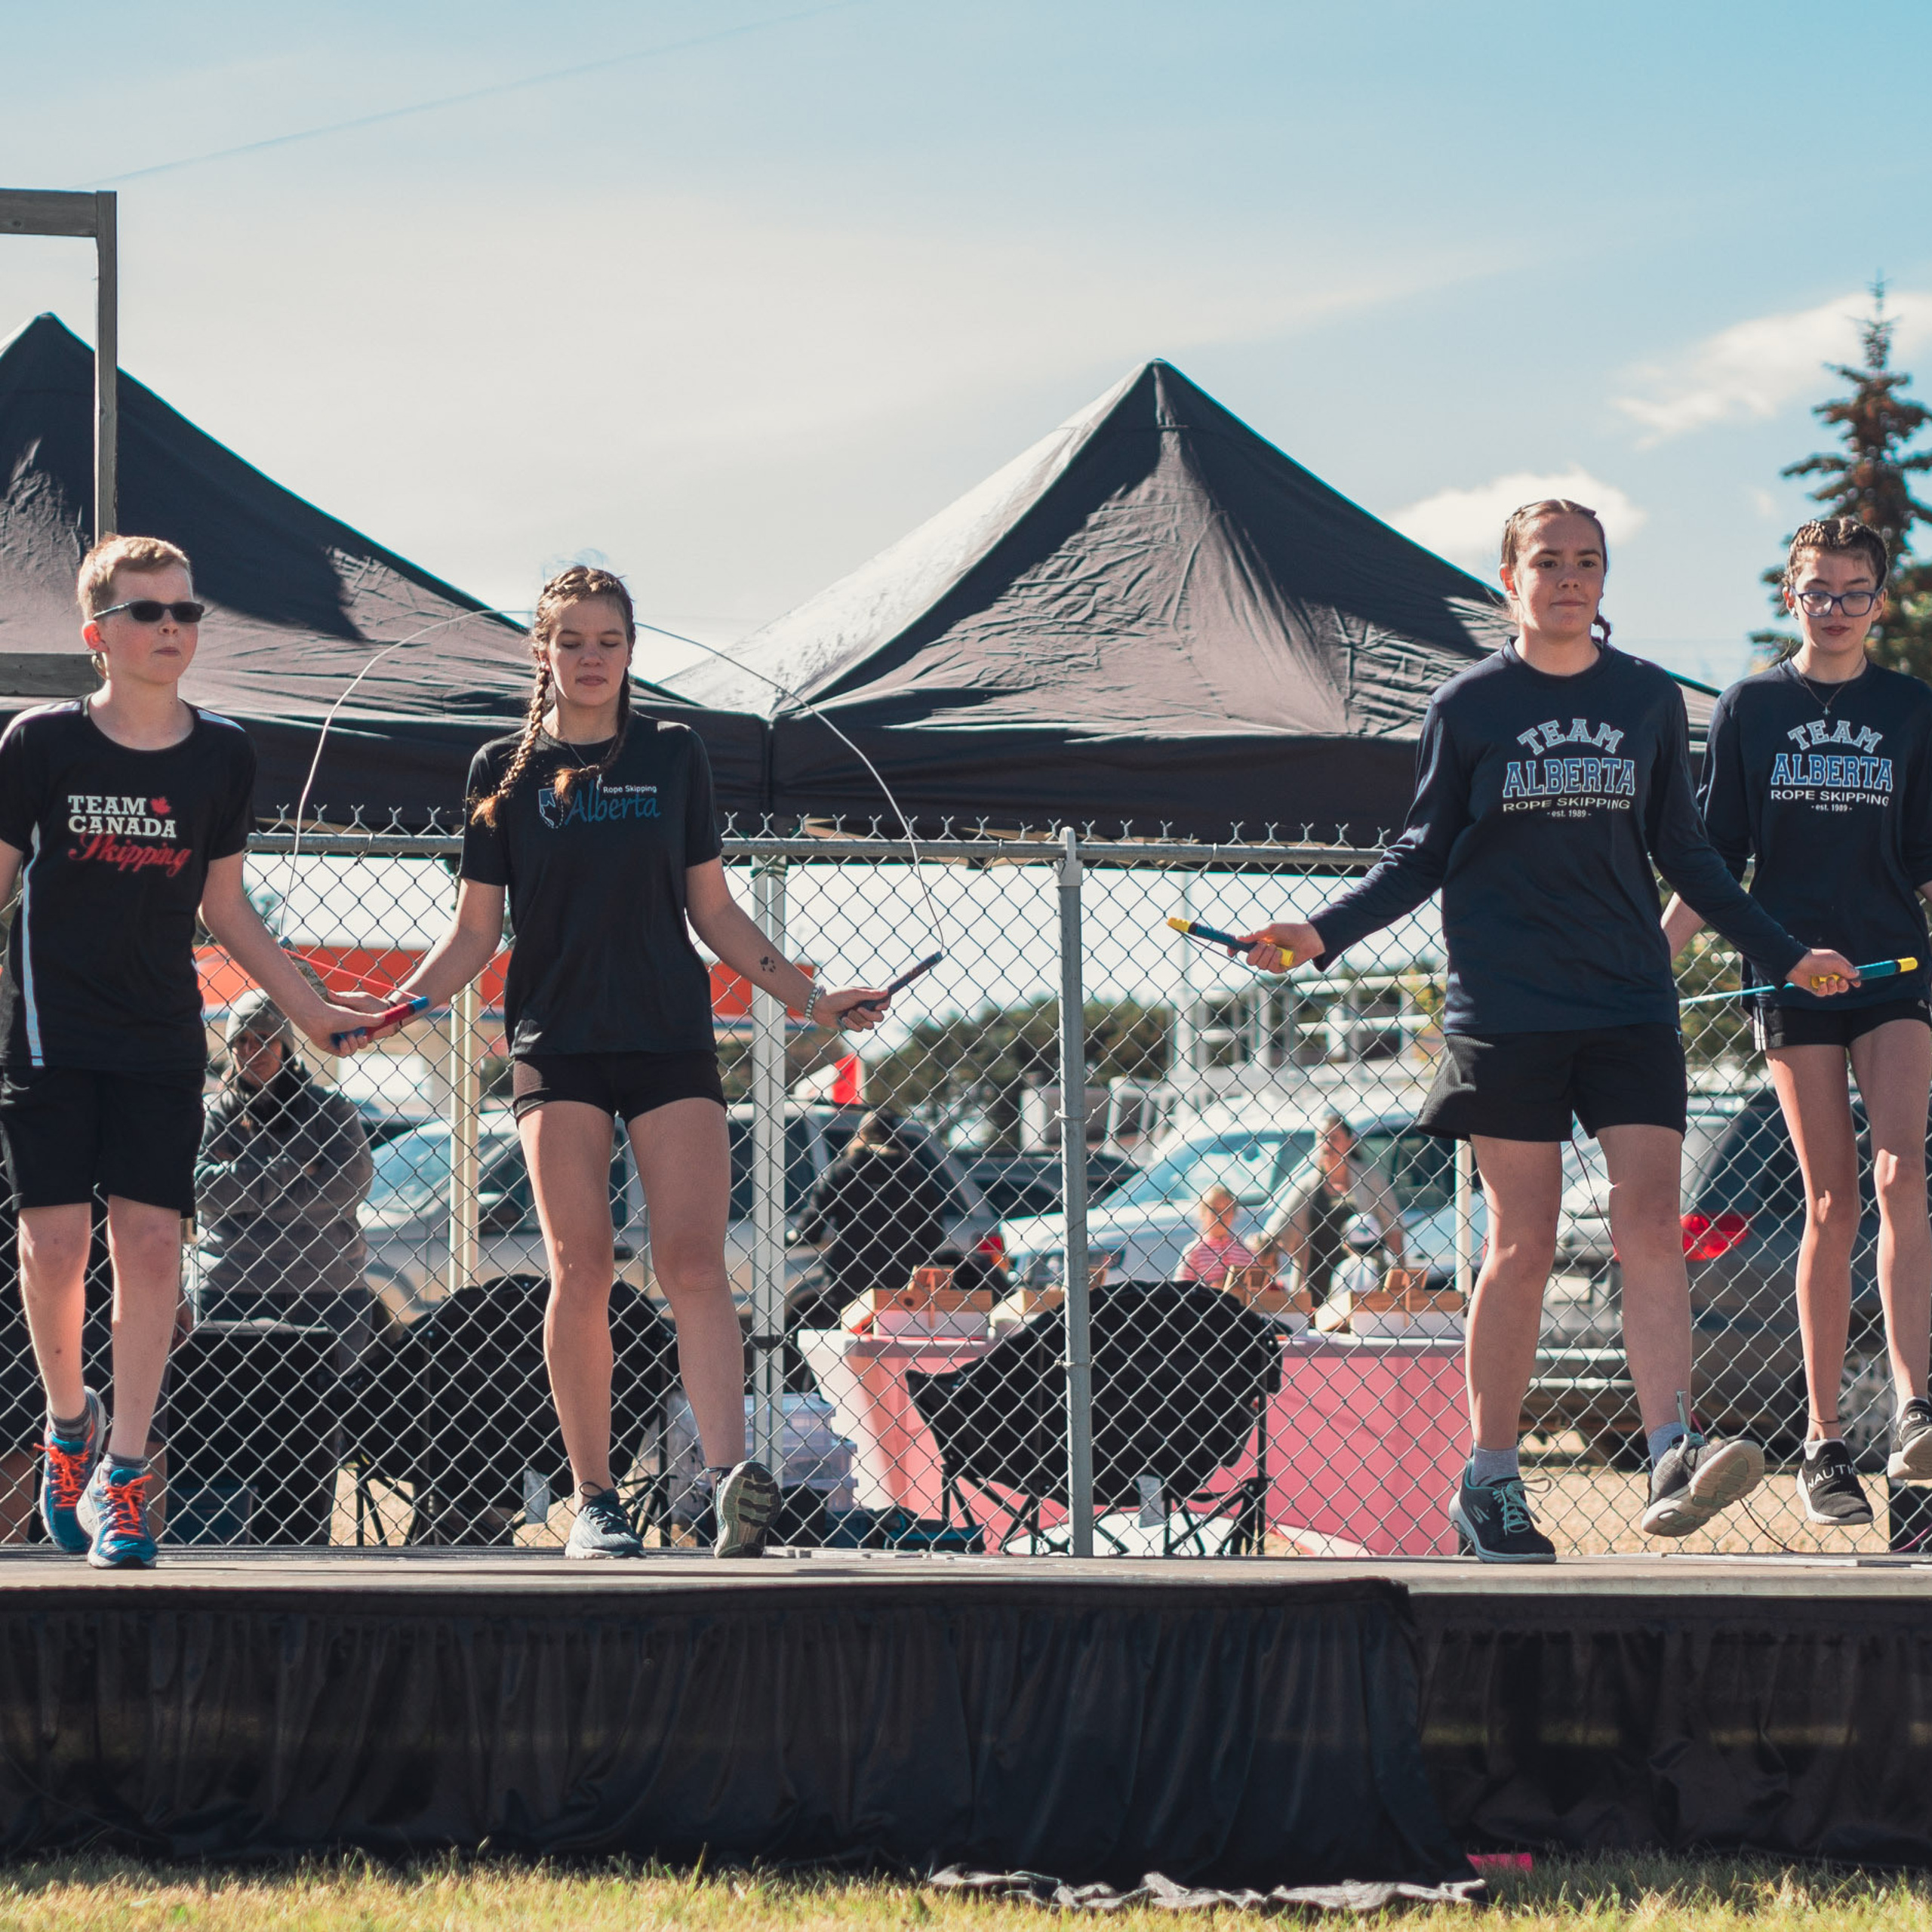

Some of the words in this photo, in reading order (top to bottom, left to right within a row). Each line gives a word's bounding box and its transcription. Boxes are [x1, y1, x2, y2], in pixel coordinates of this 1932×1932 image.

[1516, 718, 1624, 755] TEAM
[1786, 719, 1883, 754] TEAM
[603, 786, 623, 794] Rope
[625, 785, 657, 793] Skipping
[1503, 757, 1635, 798] ALBERTA
[1770, 752, 1894, 792] ALBERTA
[67, 795, 147, 816] TEAM
[565, 778, 661, 826] Alberta
[1503, 798, 1552, 813] ROPE
[1556, 796, 1631, 811] SKIPPING
[1770, 789, 1816, 800] ROPE
[1820, 790, 1890, 807] SKIPPING
[68, 815, 177, 838] CANADA
[67, 830, 192, 878] Skipping
